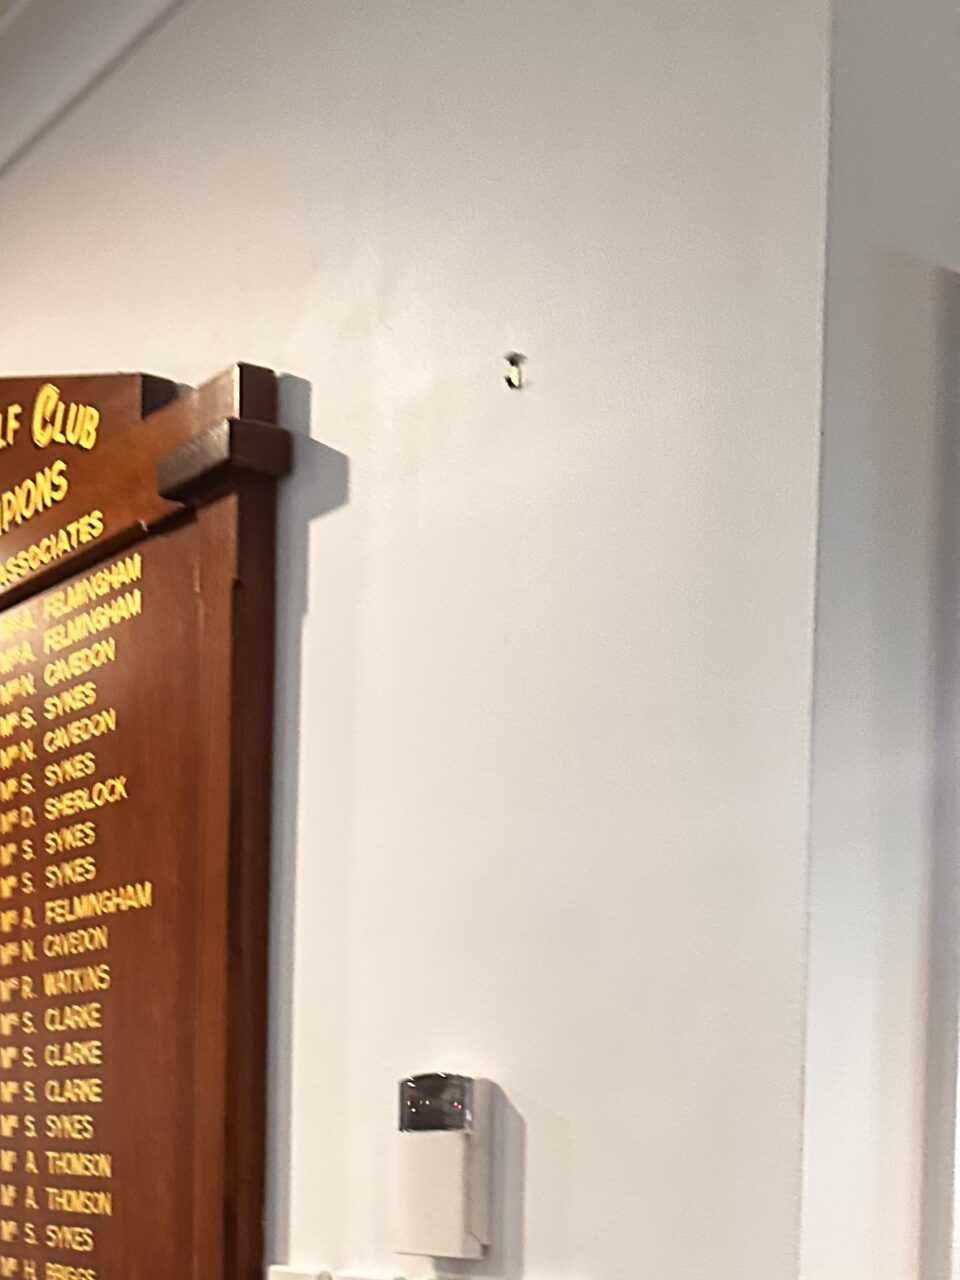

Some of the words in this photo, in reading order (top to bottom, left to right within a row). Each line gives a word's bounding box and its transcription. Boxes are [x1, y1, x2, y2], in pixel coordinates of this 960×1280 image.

[32, 383, 100, 450] CLUB
[43, 553, 141, 621] FELMINGHAM
[43, 588, 141, 654] FELMINGHAM
[45, 638, 115, 685] CAVEDON
[44, 682, 95, 718] SYKES
[44, 709, 115, 751] CAVEDON
[45, 752, 94, 786] SYKES
[45, 777, 126, 819] SHERLOCK
[45, 822, 94, 853] SYKES
[46, 857, 95, 887] SYKES
[46, 883, 151, 922] FELMINGHAM
[44, 926, 107, 956] CAVEDON
[44, 964, 109, 995] WATKINS
[45, 1003, 100, 1030] CLARKE
[45, 1041, 101, 1065] CLARKE
[46, 1079, 101, 1102] CLARKE
[46, 1115, 92, 1138] SYKES
[46, 1225, 92, 1250] SYKES
